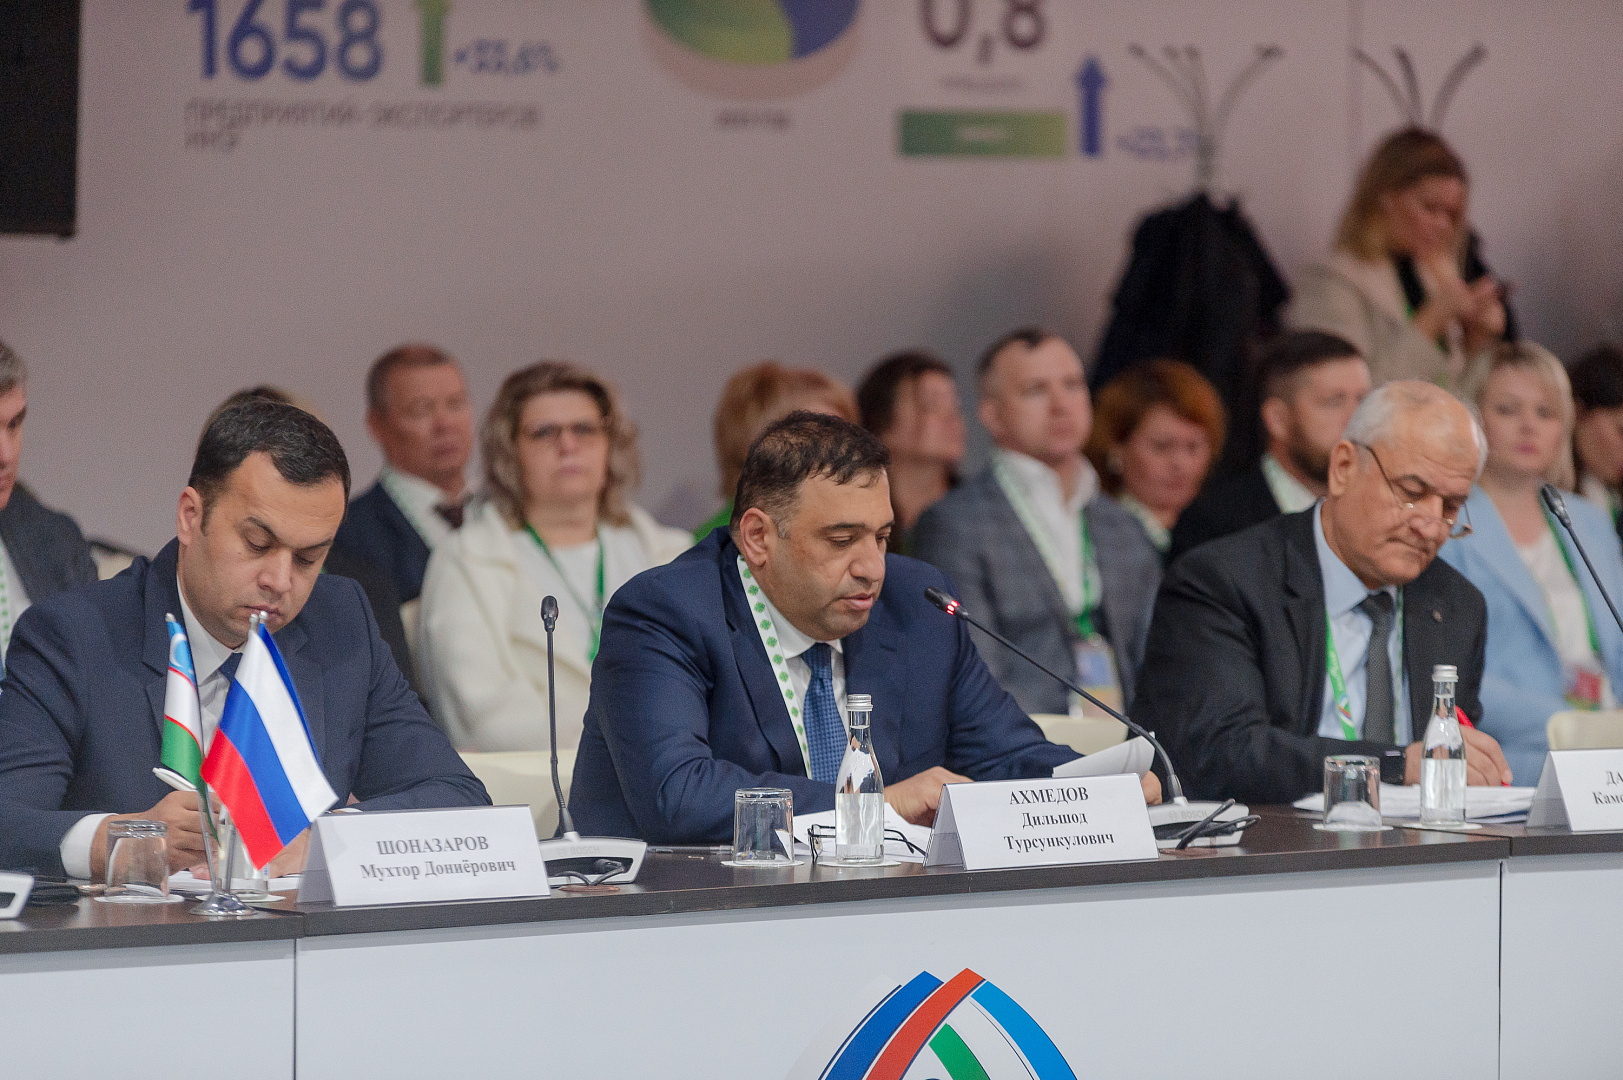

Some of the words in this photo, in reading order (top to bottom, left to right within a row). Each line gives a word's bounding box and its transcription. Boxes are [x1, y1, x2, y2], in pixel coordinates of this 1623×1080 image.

[187, 0, 383, 81] 1658
[1009, 786, 1089, 805] АХМЕДОВ
[1022, 812, 1088, 829] Дильшод
[1181, 809, 1208, 819] BOSCH
[376, 835, 489, 855] ШОНАЗАРОВ
[1004, 833, 1115, 853] Турсункулович
[360, 863, 420, 882] Мухтор
[424, 858, 516, 877] Дониёрович
